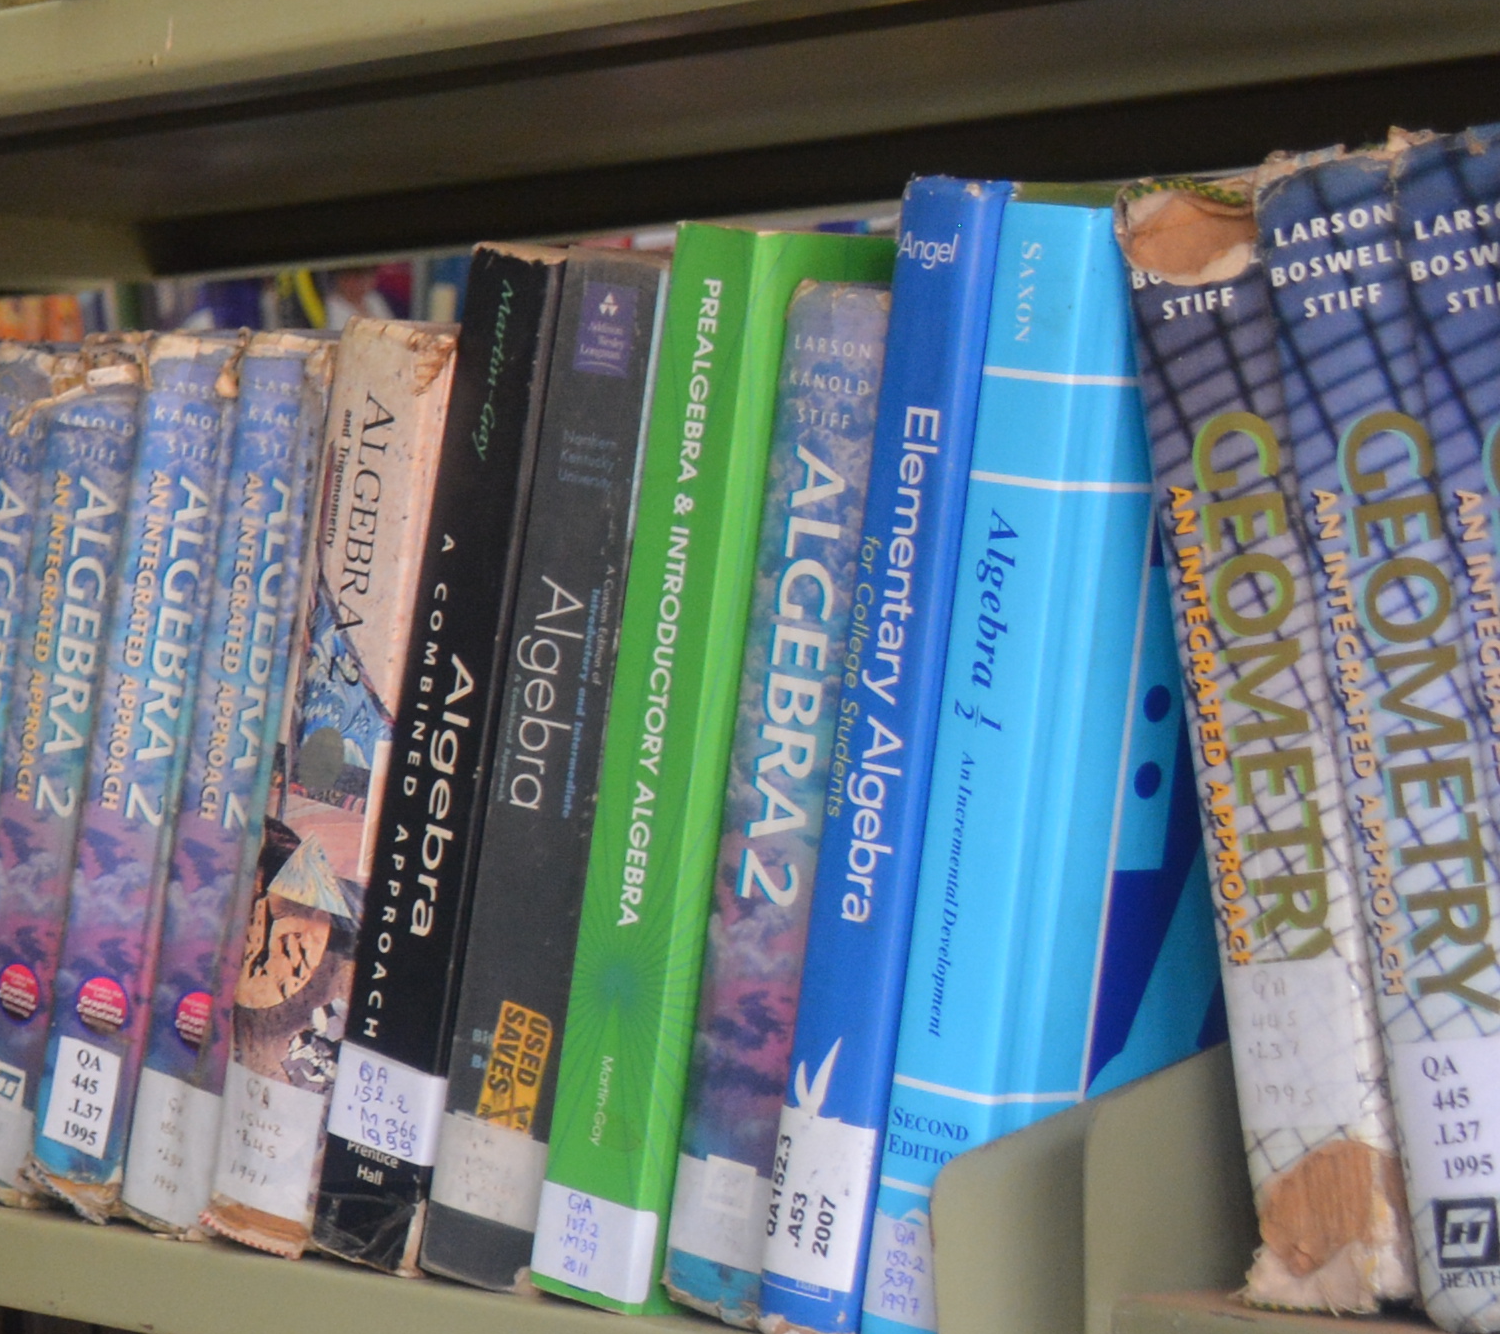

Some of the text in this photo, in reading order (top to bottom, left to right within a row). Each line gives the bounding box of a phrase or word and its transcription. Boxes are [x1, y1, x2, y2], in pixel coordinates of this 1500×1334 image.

[900, 234, 959, 269] Angel
[1270, 239, 1401, 288] BOSWELL
[1273, 203, 1396, 248] LARSON
[1012, 241, 1042, 343] SAXON
[1303, 285, 1383, 318] STIFF
[327, 408, 353, 548] and Trigonometry
[336, 391, 396, 632] ALGEBRA
[617, 278, 723, 926] PREALGEBRA & INTRODUCTORY ALGEBRA
[510, 575, 584, 810] Algebra
[736, 444, 846, 909] ALGEBRA 2
[827, 535, 882, 819] for College Students
[840, 405, 940, 925] Elementary Algebra
[1311, 488, 1406, 998] AN INTEGRATED APPROACH
[1337, 411, 1500, 1016] GEOMETRY
[363, 535, 456, 1039] A COMBINED APPROACH
[409, 653, 475, 937] Algebra
[928, 751, 976, 1038] An Incremental Development
[72, 1073, 98, 1094] 445
[76, 1050, 102, 1072] QA
[487, 1006, 528, 1095] SAVES
[516, 1016, 551, 1088] USED
[63, 1121, 97, 1146] 1995
[68, 1098, 102, 1121] .L37
[591, 1056, 614, 1147] Martin-Gay
[346, 1138, 399, 1169] Prentice
[356, 1164, 384, 1186] Hall
[764, 1134, 794, 1238] QA152.3
[791, 1191, 809, 1249] .A53
[812, 1196, 838, 1258] 2007
